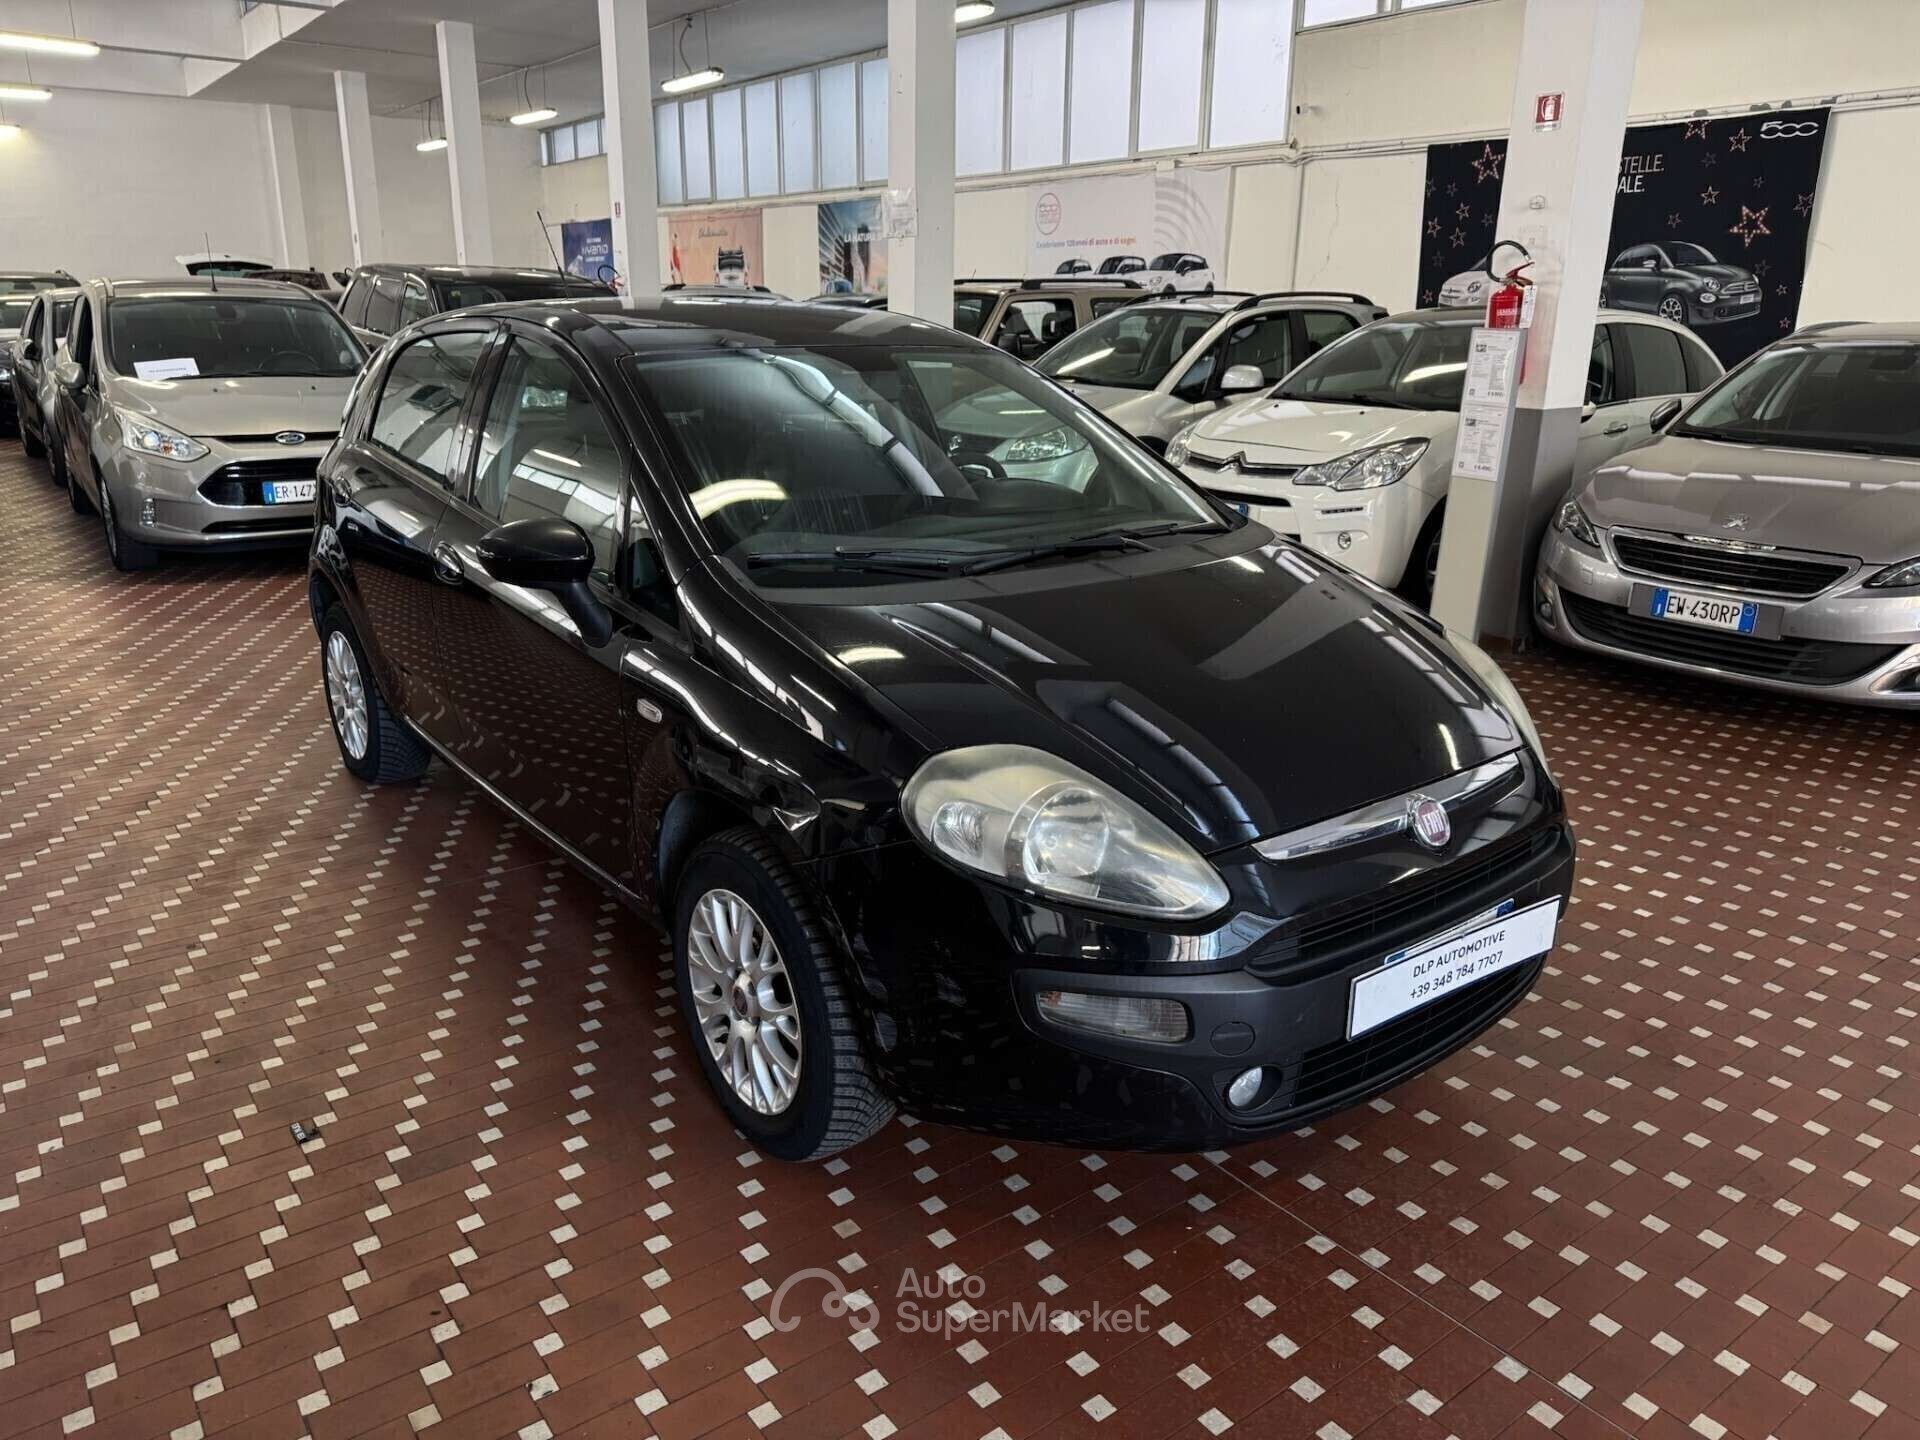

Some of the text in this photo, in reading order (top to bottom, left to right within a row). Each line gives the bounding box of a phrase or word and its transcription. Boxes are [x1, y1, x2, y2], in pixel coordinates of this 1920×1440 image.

[1760, 120, 1819, 139] 500
[275, 484, 315, 499] ER 147
[1666, 595, 1740, 624] EW 430RP
[1412, 930, 1506, 979] DLP AUTOMOTIVE
[1409, 951, 1504, 1000] +39 348 784 7707
